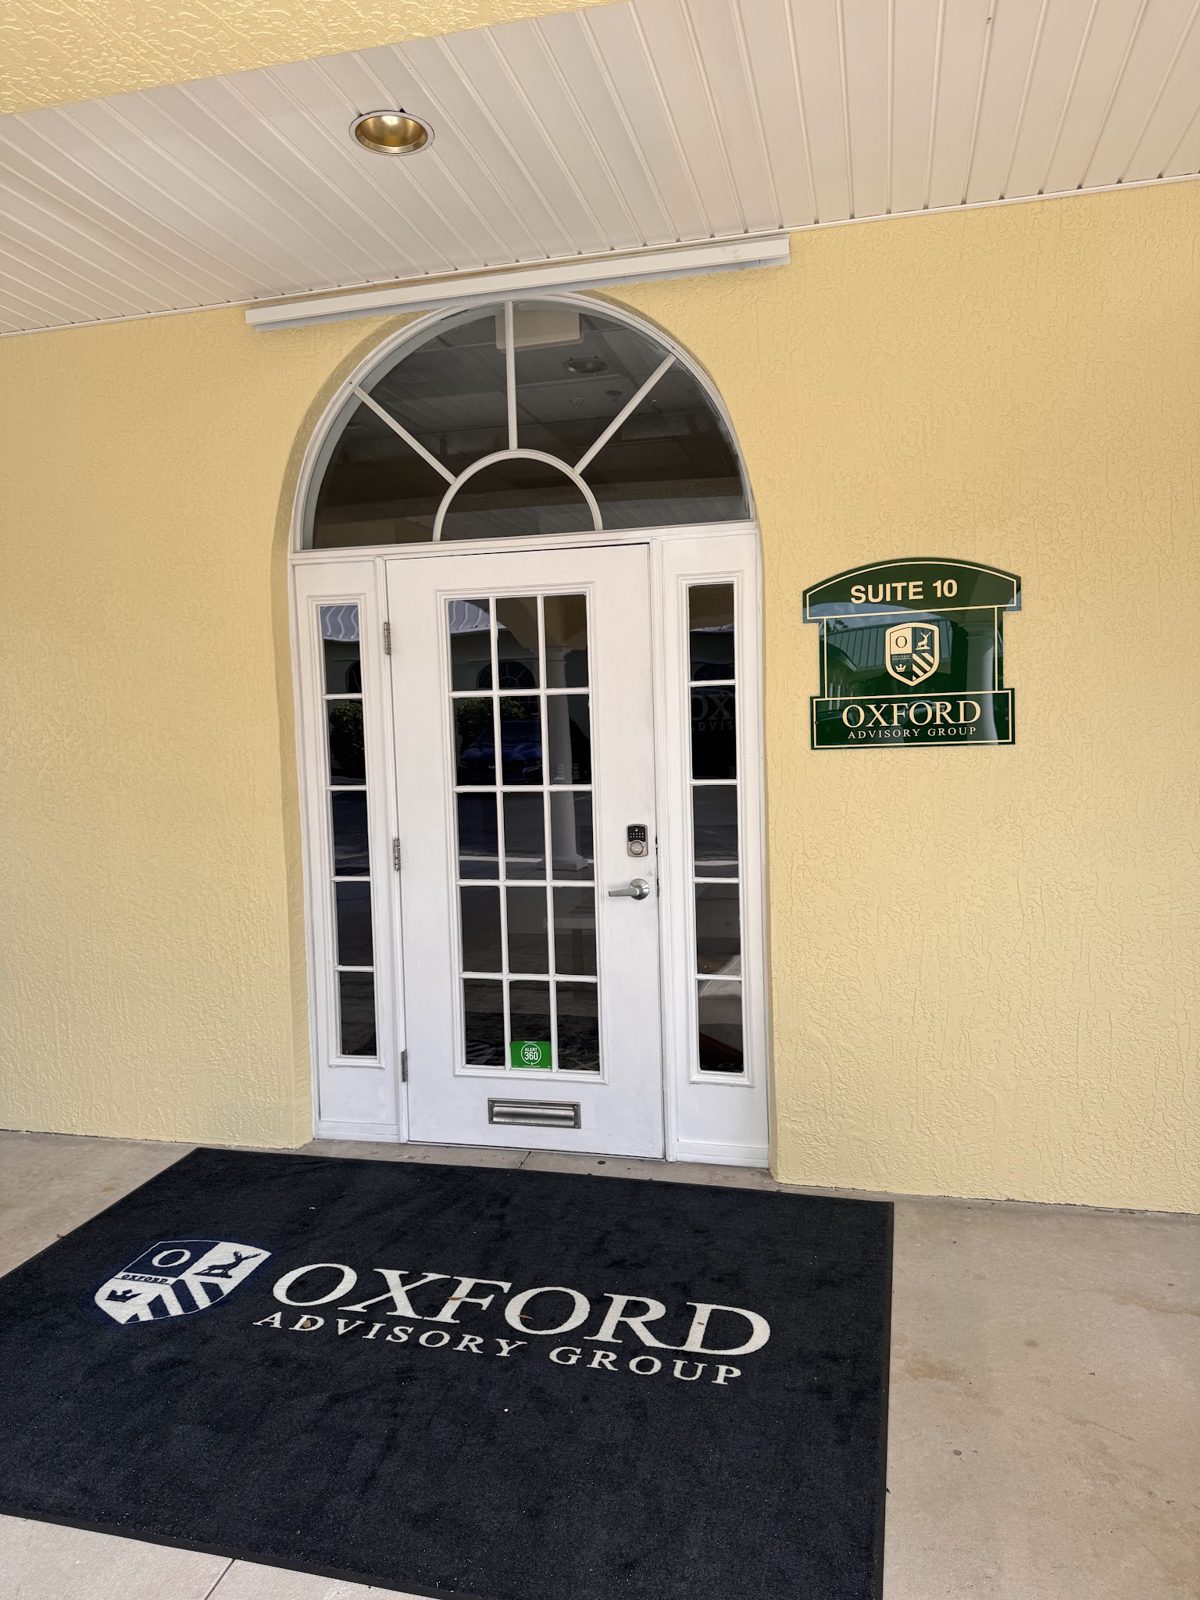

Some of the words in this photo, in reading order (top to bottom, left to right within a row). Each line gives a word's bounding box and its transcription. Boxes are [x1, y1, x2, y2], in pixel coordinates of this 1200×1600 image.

[850, 581, 924, 604] SUITE
[932, 579, 958, 598] 10
[895, 635, 908, 649] O
[842, 700, 981, 728] OXFORD
[848, 729, 921, 739] ADVISORY
[927, 726, 977, 737] GROUP
[524, 1051, 538, 1060] 360
[152, 1249, 191, 1267] O
[121, 1274, 168, 1284] OXFORD
[271, 1263, 772, 1356] OXFORD
[252, 1311, 529, 1357] ADVISORY
[548, 1346, 743, 1385] GROUP
